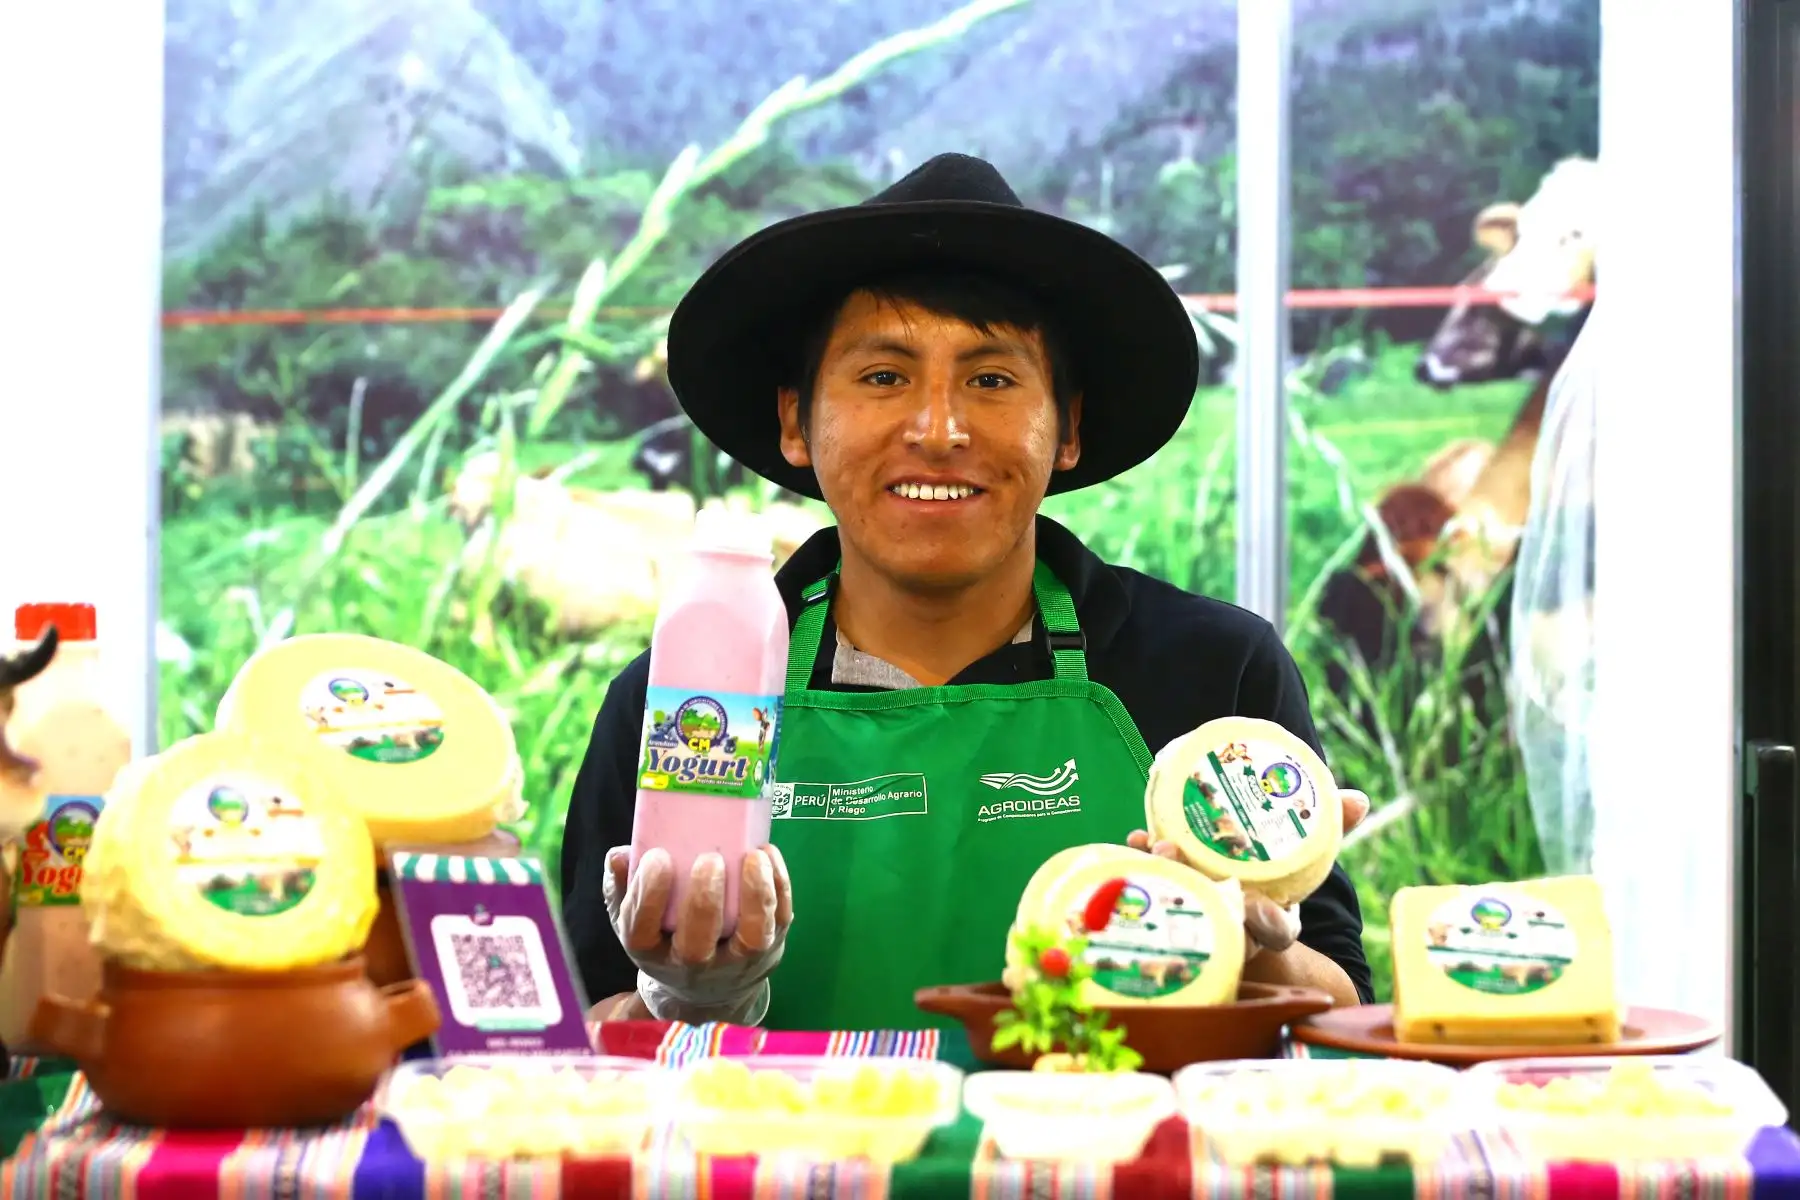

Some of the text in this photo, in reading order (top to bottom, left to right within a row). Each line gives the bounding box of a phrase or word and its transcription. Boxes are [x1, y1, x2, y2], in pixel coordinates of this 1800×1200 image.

[688, 738, 711, 752] CM
[648, 747, 750, 783] Yogurt
[831, 790, 922, 805] de Desarrollo Agrario
[832, 786, 874, 797] Ministerio
[794, 793, 826, 807] PERÚ
[978, 795, 1081, 816] AGROIDEAS
[829, 806, 866, 815] y Riego
